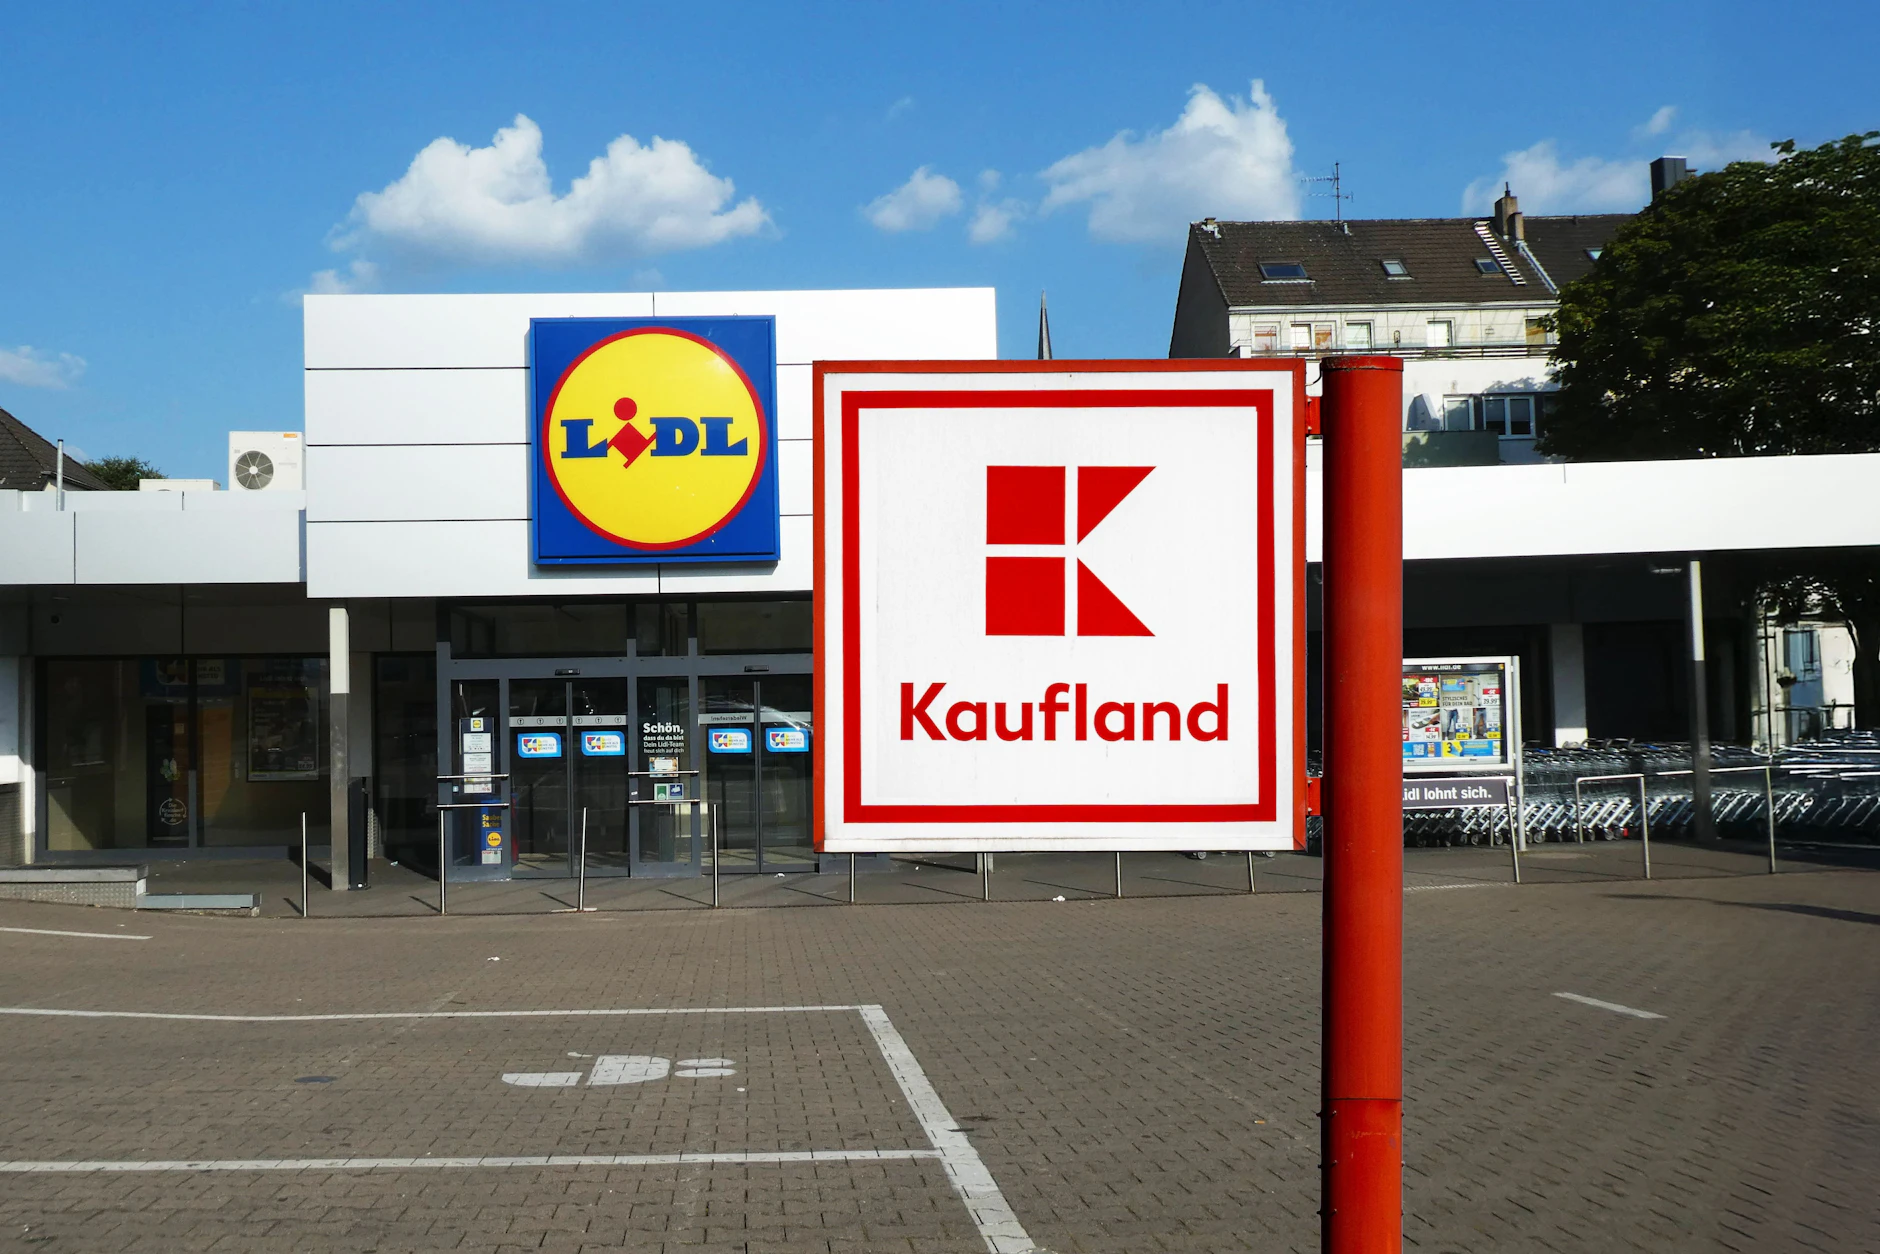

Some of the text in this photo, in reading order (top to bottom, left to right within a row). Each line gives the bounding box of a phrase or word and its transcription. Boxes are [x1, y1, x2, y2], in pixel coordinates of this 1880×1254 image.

[900, 682, 1229, 742] Kaufland
[643, 722, 684, 735] Schön,
[1402, 785, 1492, 801] idl lohnt sich.
